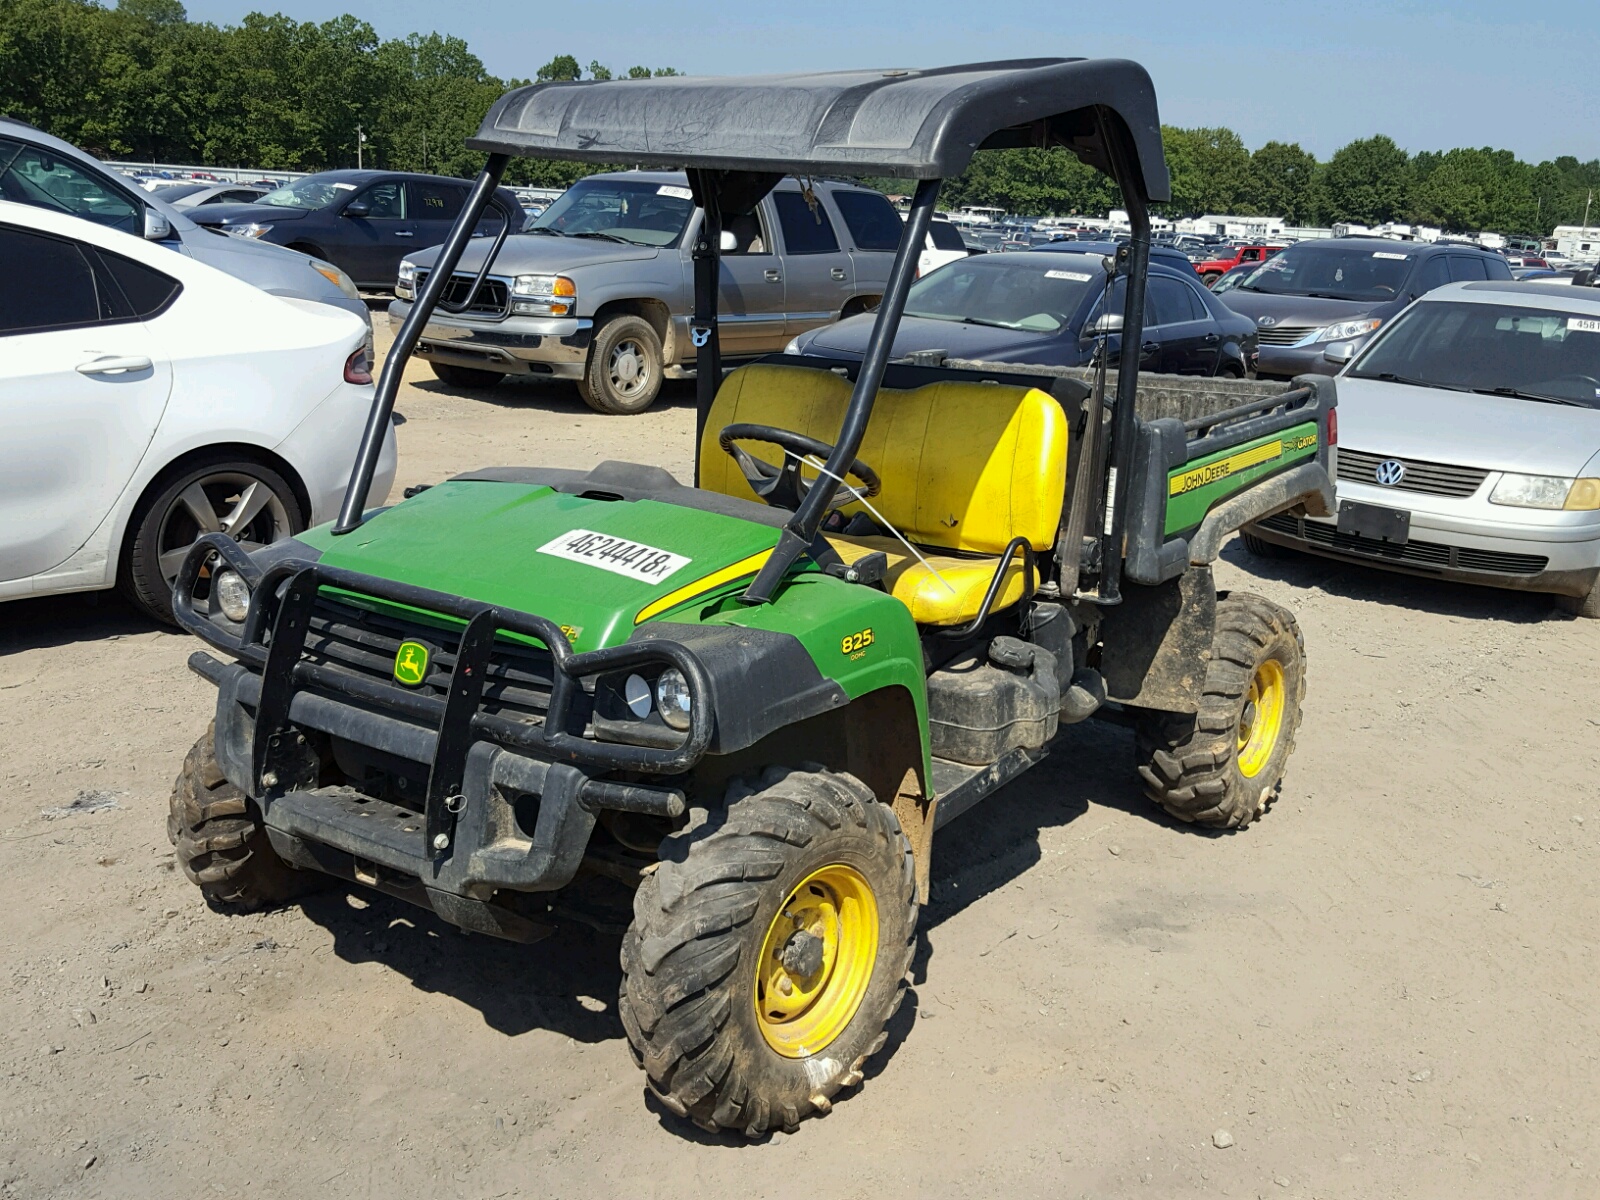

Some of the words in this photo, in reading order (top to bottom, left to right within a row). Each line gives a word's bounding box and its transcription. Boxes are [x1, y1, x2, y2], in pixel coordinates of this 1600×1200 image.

[1297, 434, 1317, 449] GATOR
[1181, 471, 1204, 492] JOHN
[1204, 462, 1231, 483] DEERE
